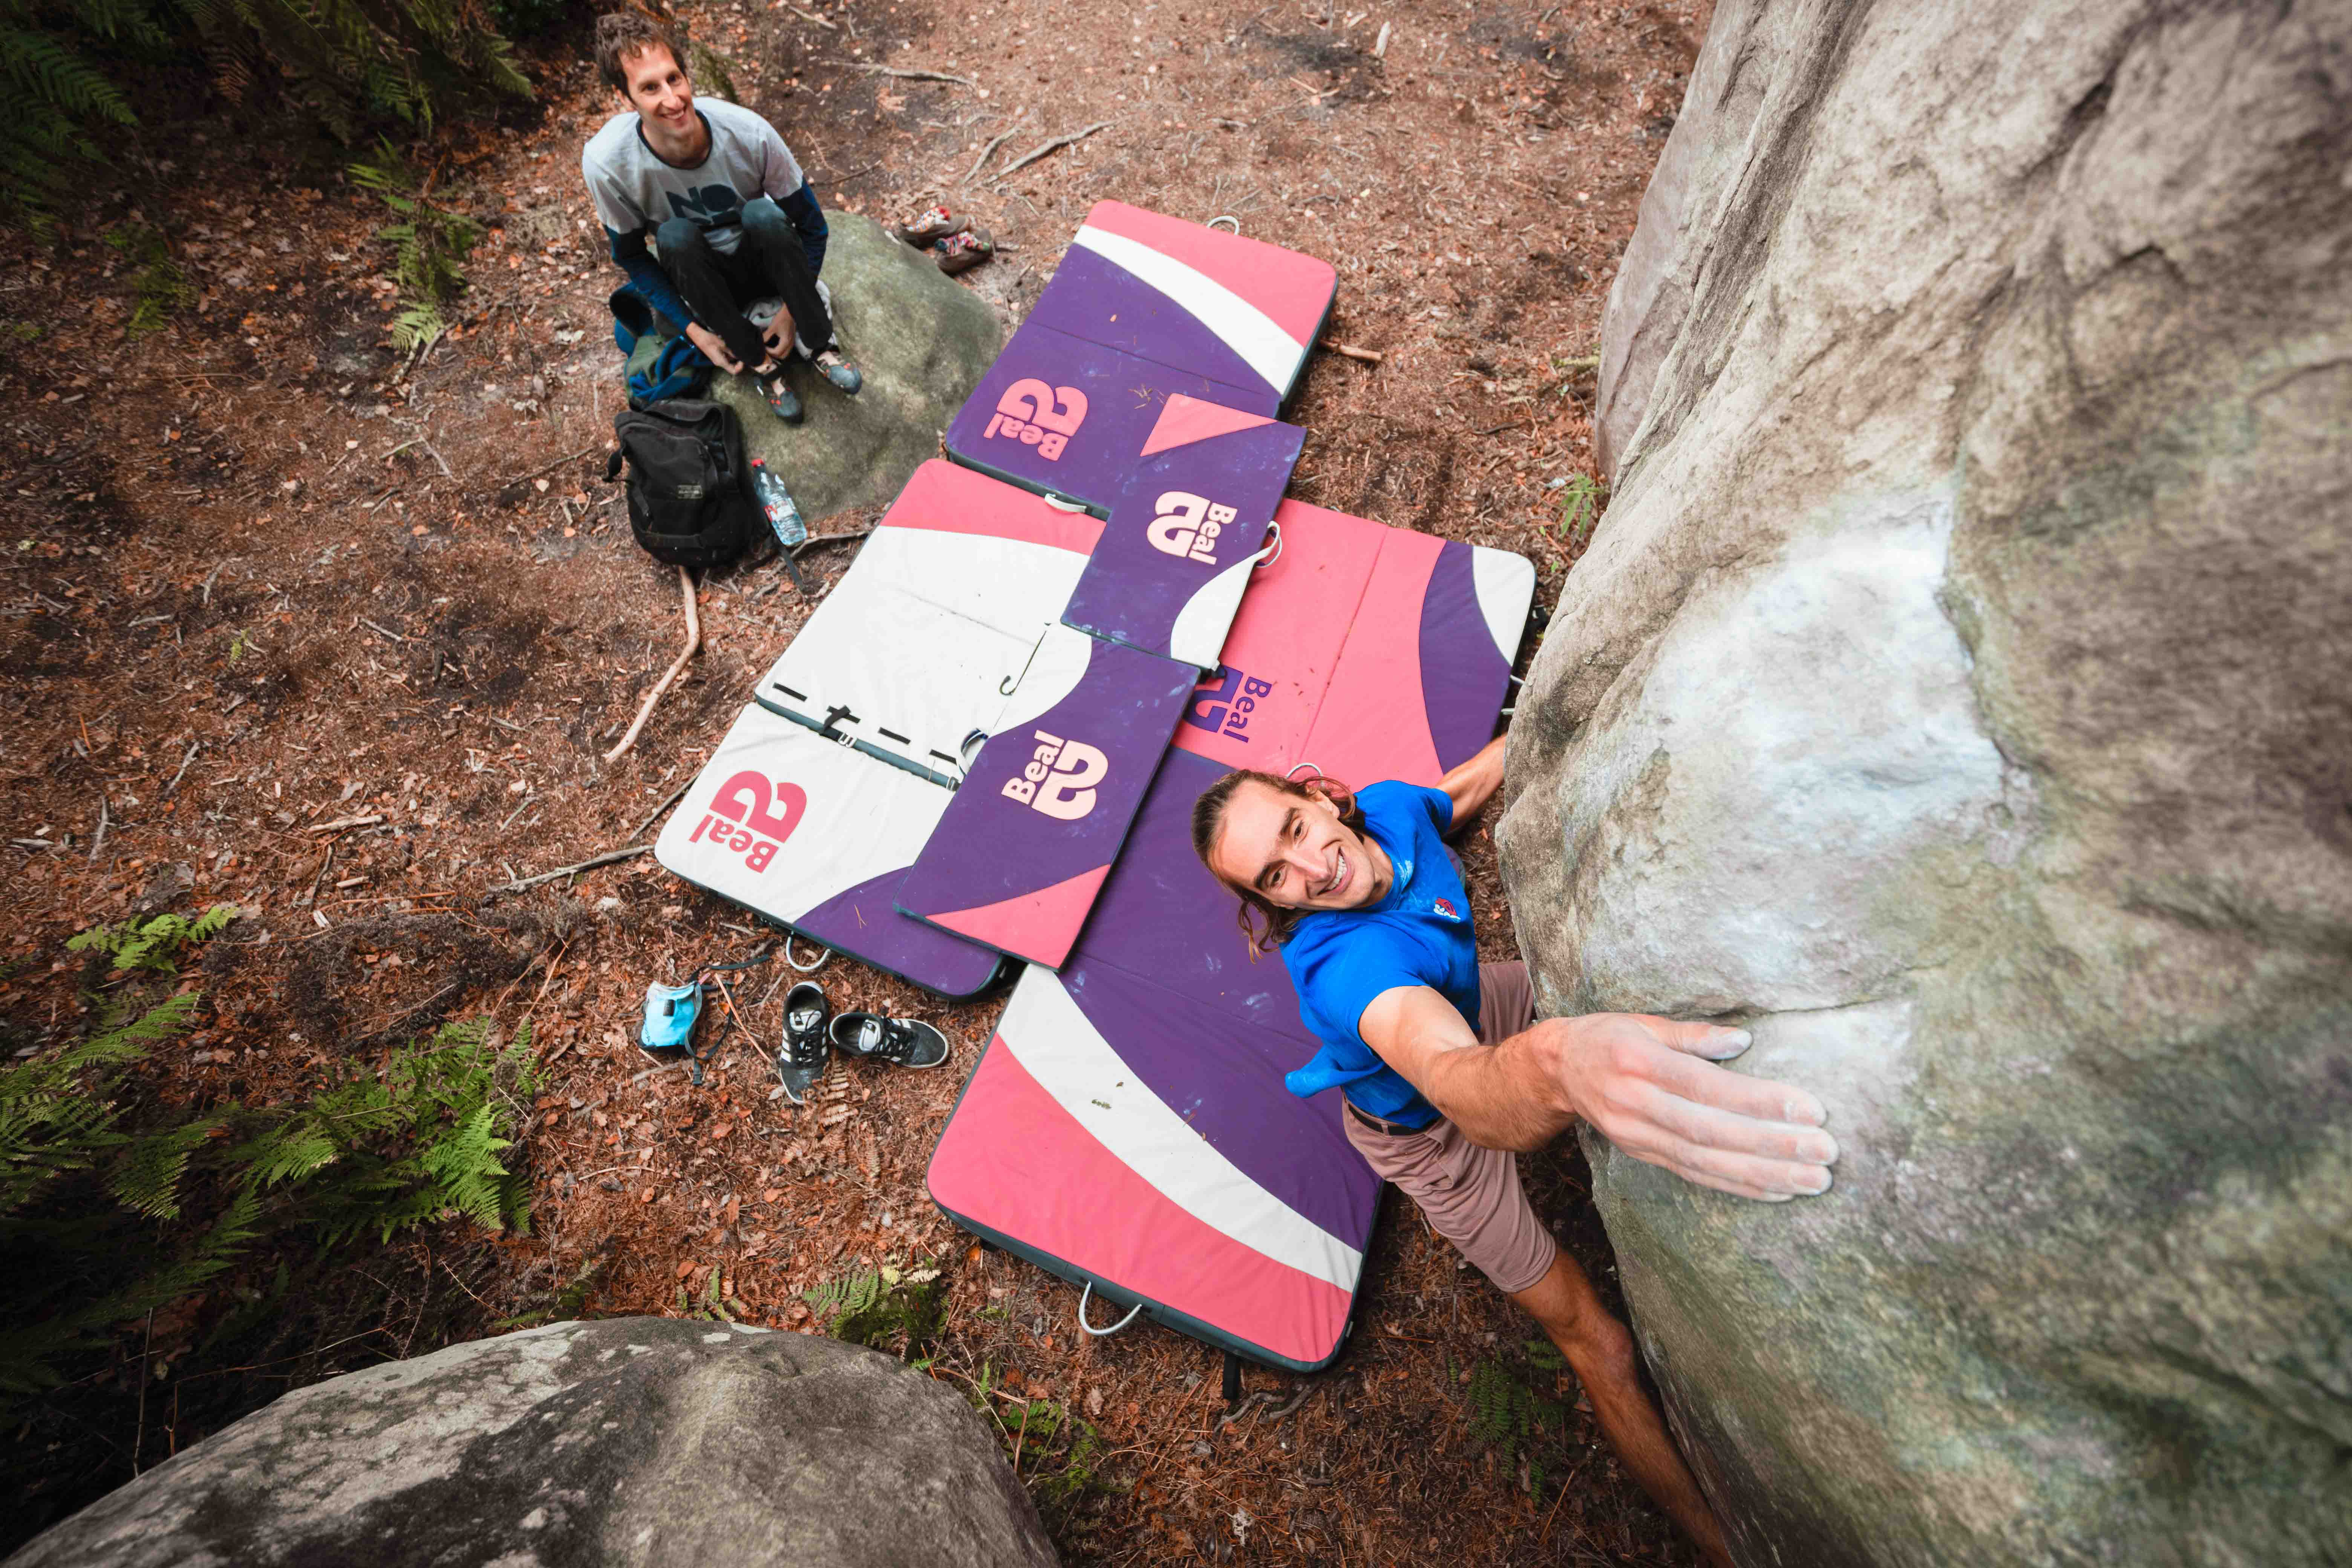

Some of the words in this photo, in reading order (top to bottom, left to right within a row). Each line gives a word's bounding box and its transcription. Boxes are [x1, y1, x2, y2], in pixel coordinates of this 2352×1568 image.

[983, 413, 1068, 461] Beal
[1188, 502, 1237, 565] Beal
[1223, 676, 1272, 743] Beal
[1001, 729, 1064, 805] Beal
[689, 814, 779, 873] Beal
